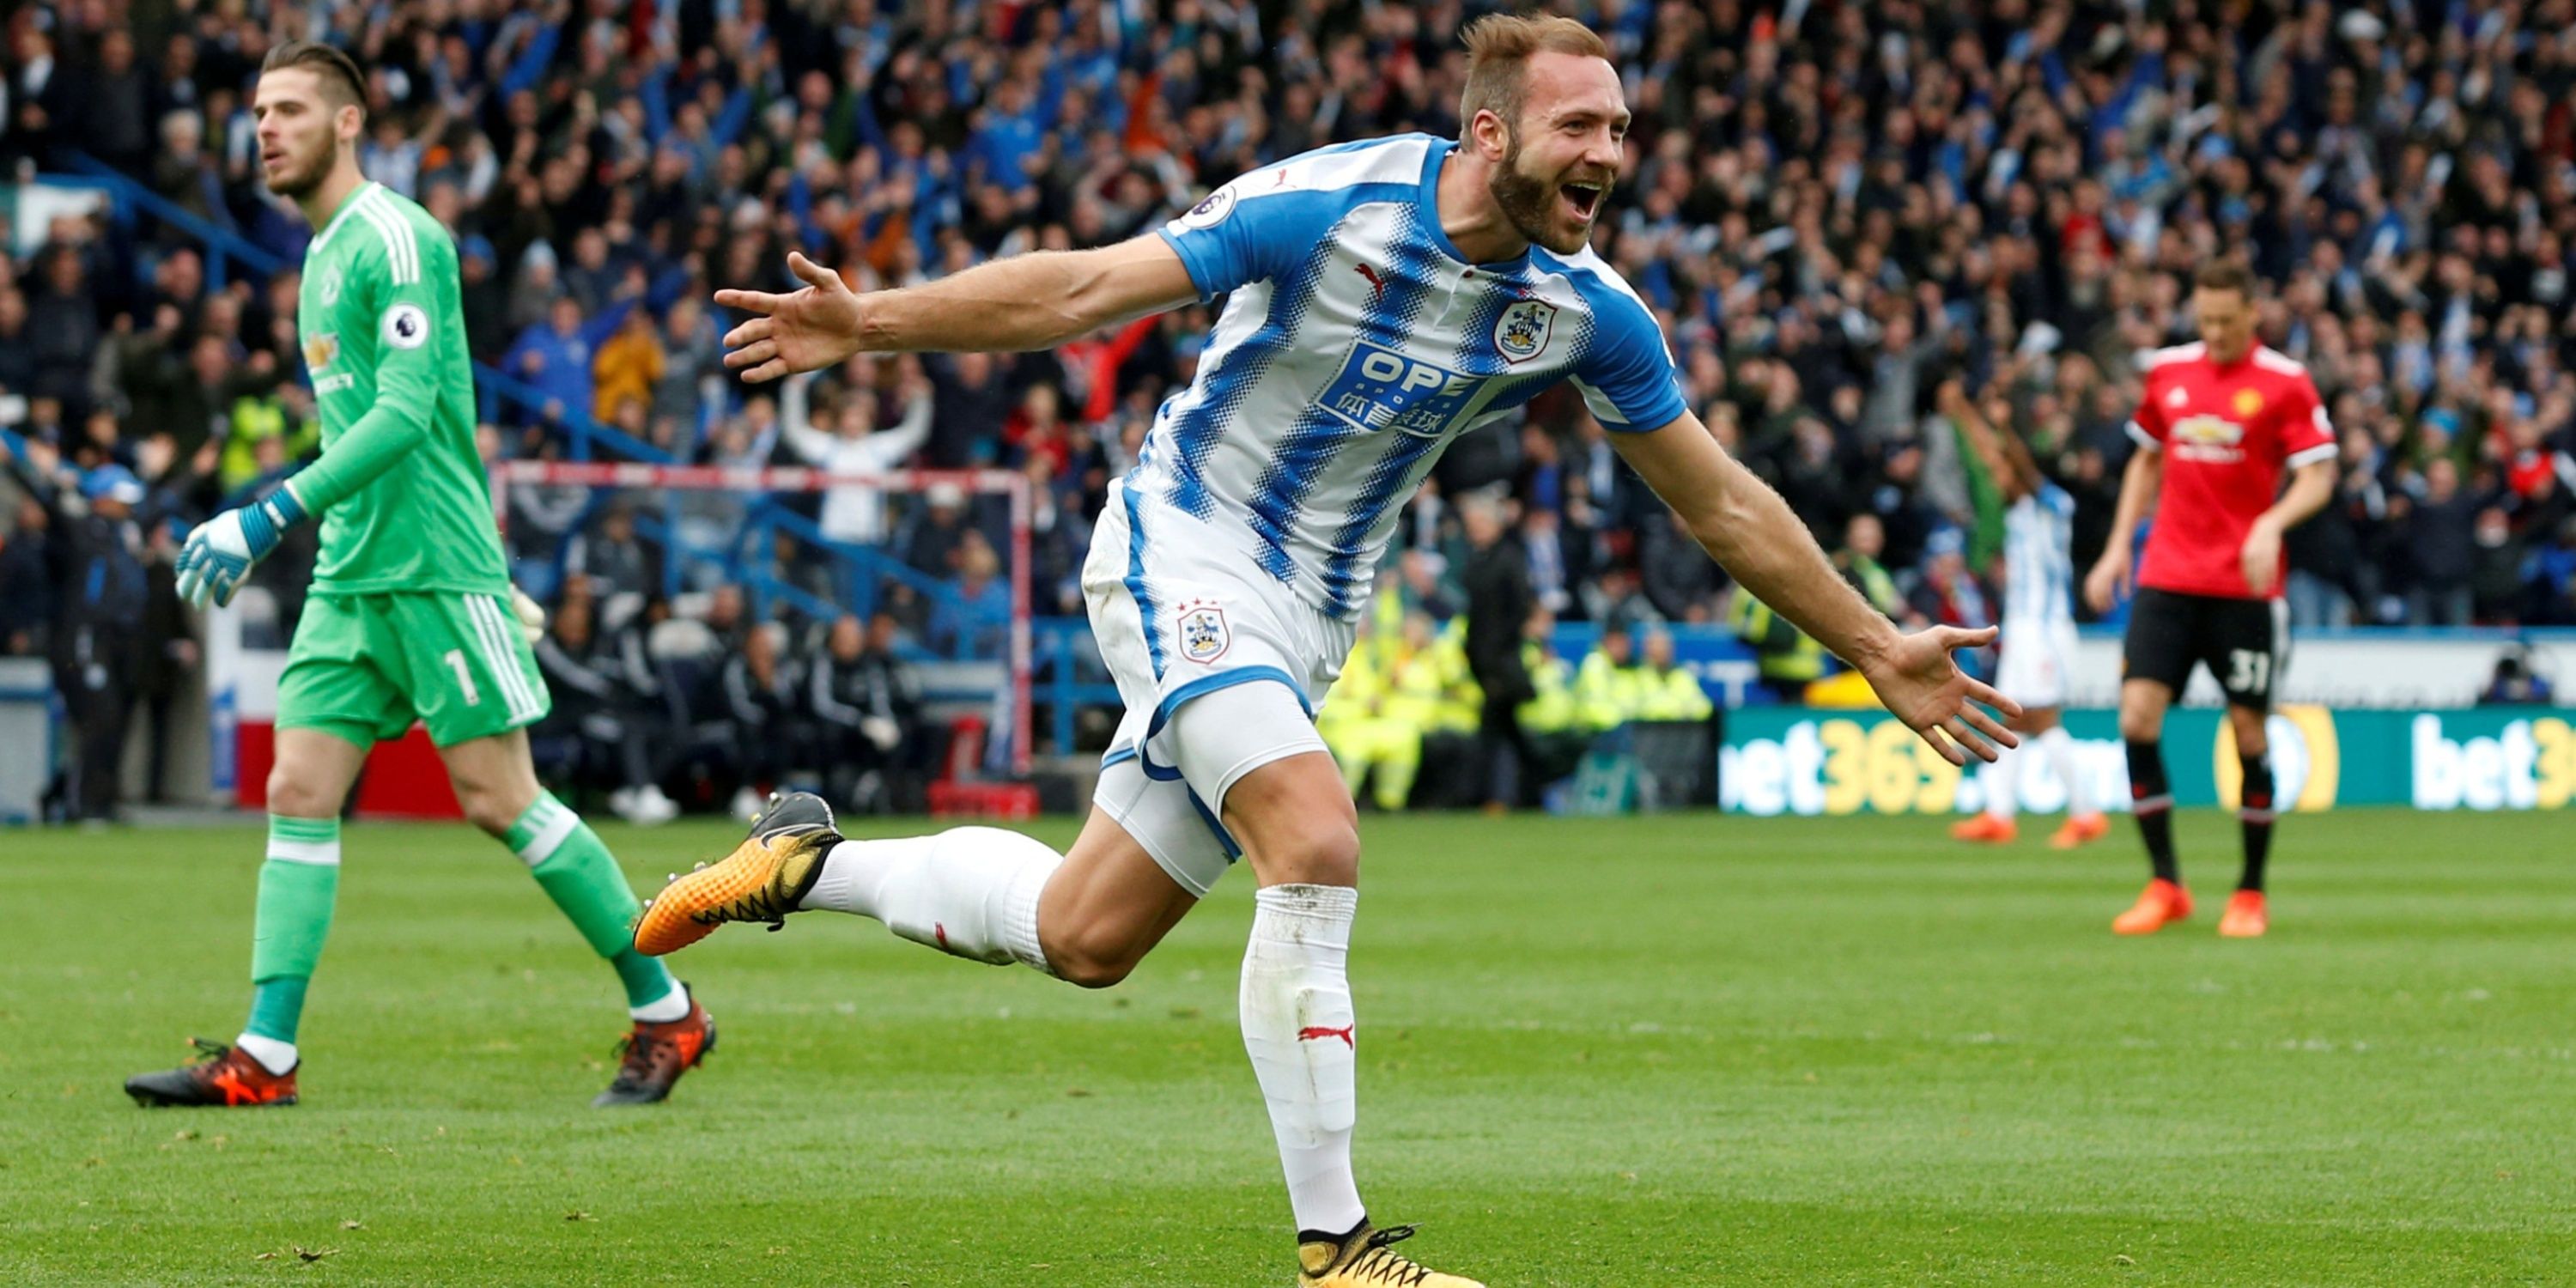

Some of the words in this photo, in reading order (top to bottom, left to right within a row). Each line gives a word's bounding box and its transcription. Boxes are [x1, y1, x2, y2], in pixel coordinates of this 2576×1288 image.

[1362, 351, 1477, 397] OPE
[445, 648, 480, 707] 1
[2227, 648, 2269, 696] 31
[2411, 713, 2576, 810] bet3
